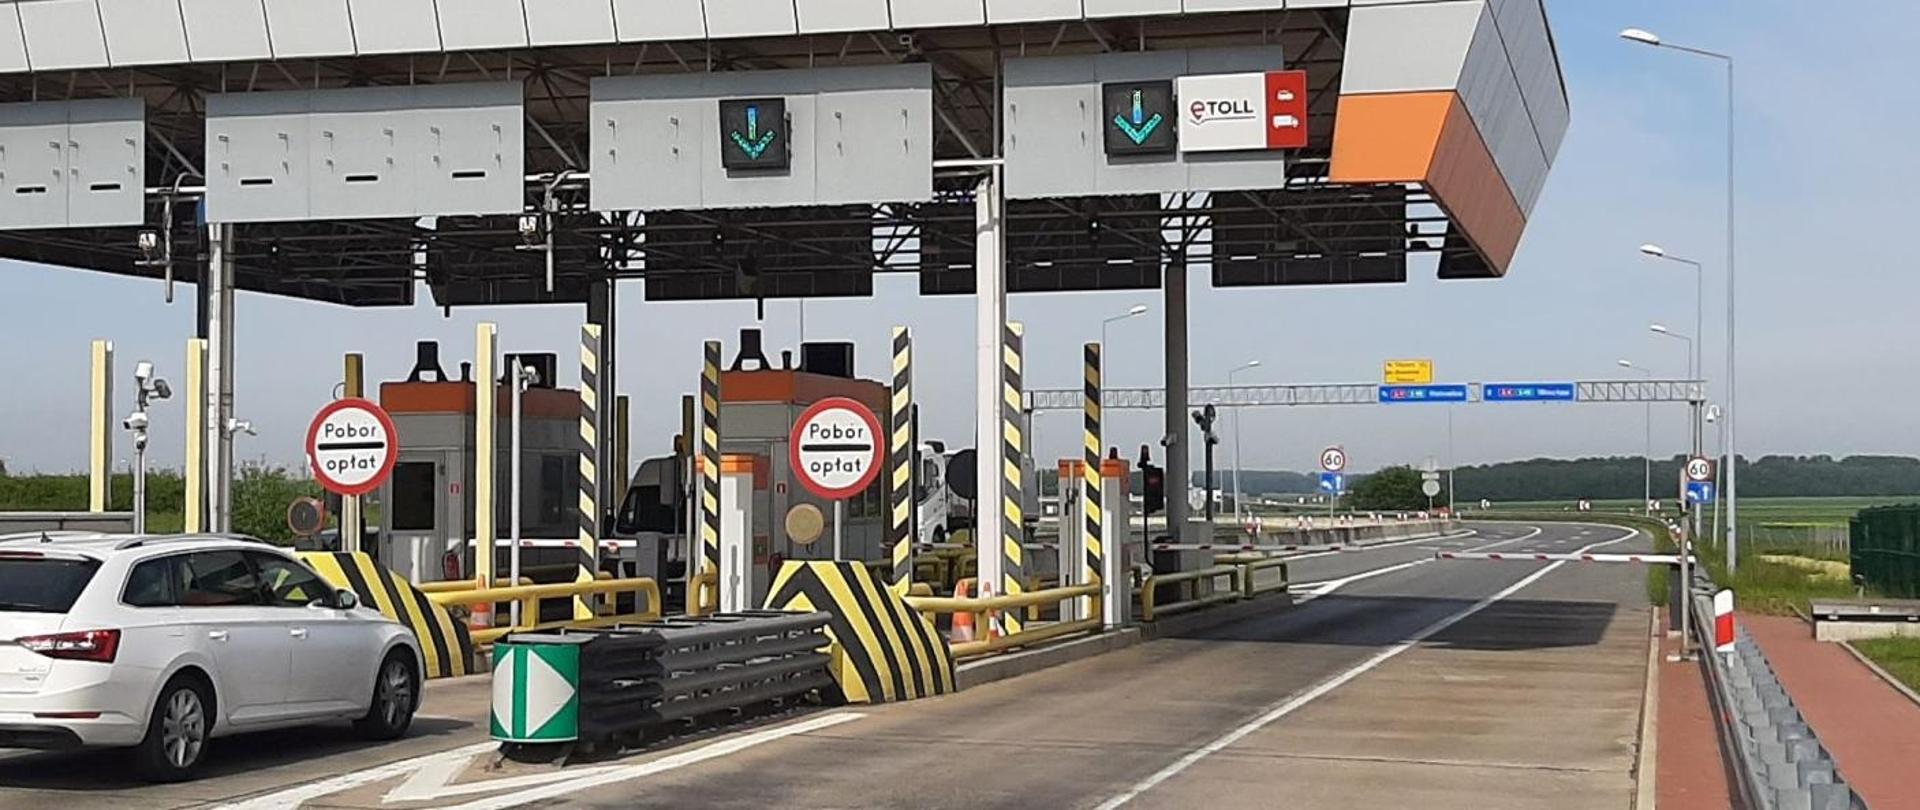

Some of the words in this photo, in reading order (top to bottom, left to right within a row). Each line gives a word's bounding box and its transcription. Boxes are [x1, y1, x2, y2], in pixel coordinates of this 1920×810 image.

[1190, 100, 1254, 120] eTOLL
[326, 454, 376, 474] opłat
[810, 457, 861, 477] opłat
[1325, 454, 1341, 466] 60
[1690, 463, 1708, 475] 60
